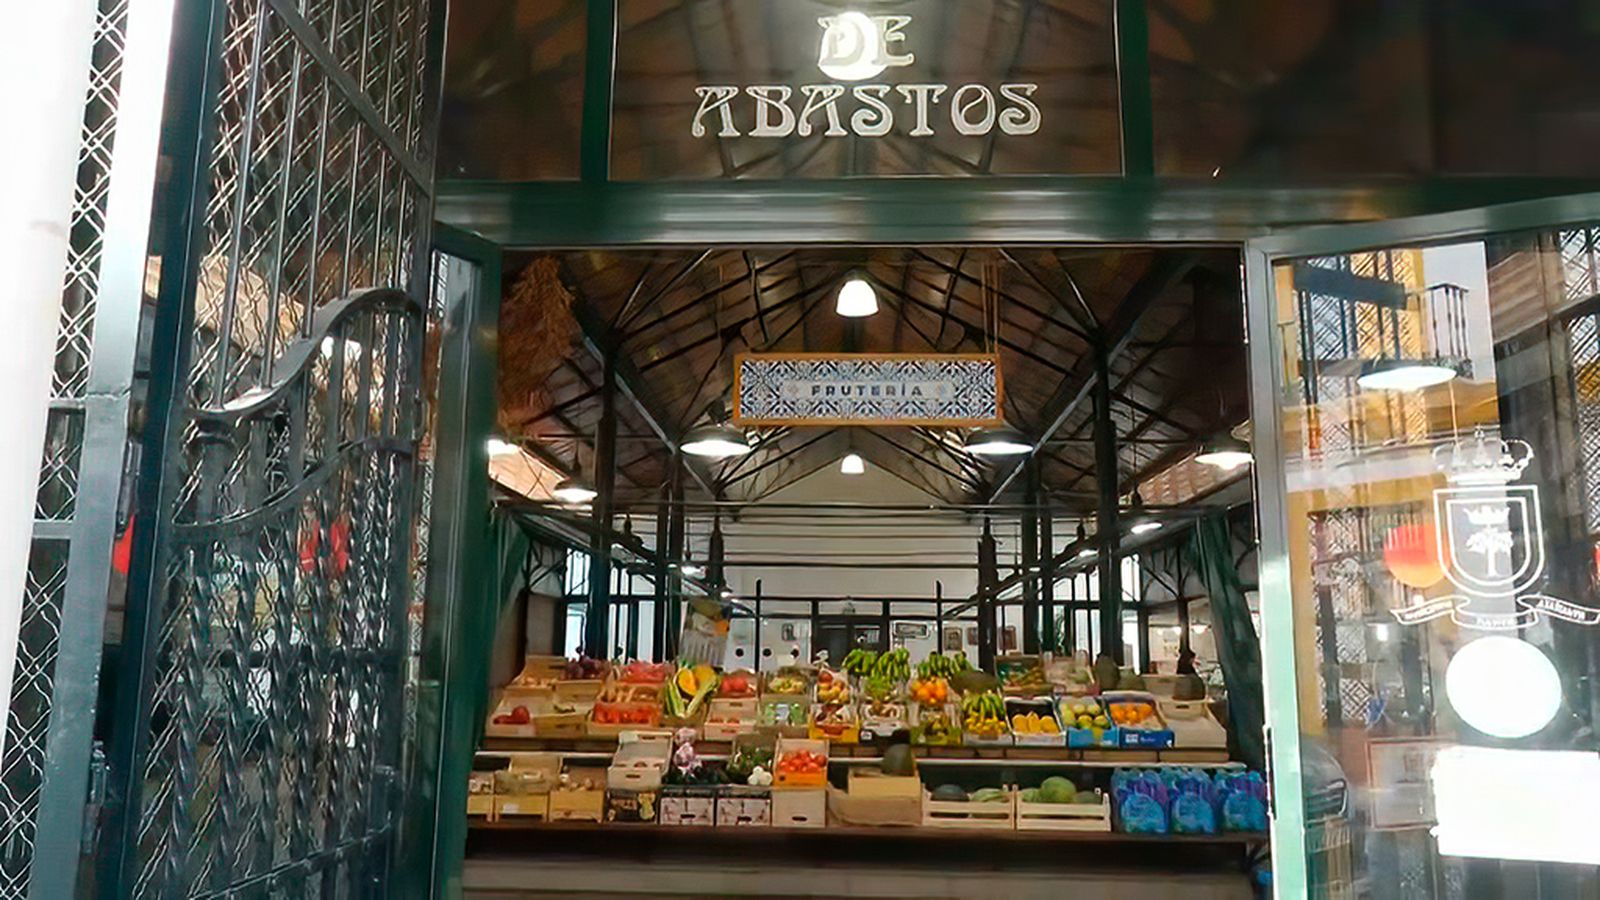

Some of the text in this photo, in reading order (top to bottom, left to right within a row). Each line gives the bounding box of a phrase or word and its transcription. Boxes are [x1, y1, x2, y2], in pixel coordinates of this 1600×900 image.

[818, 15, 914, 67] DE
[691, 84, 1042, 138] ABASTOS
[811, 382, 923, 397] FRUTERÍA
